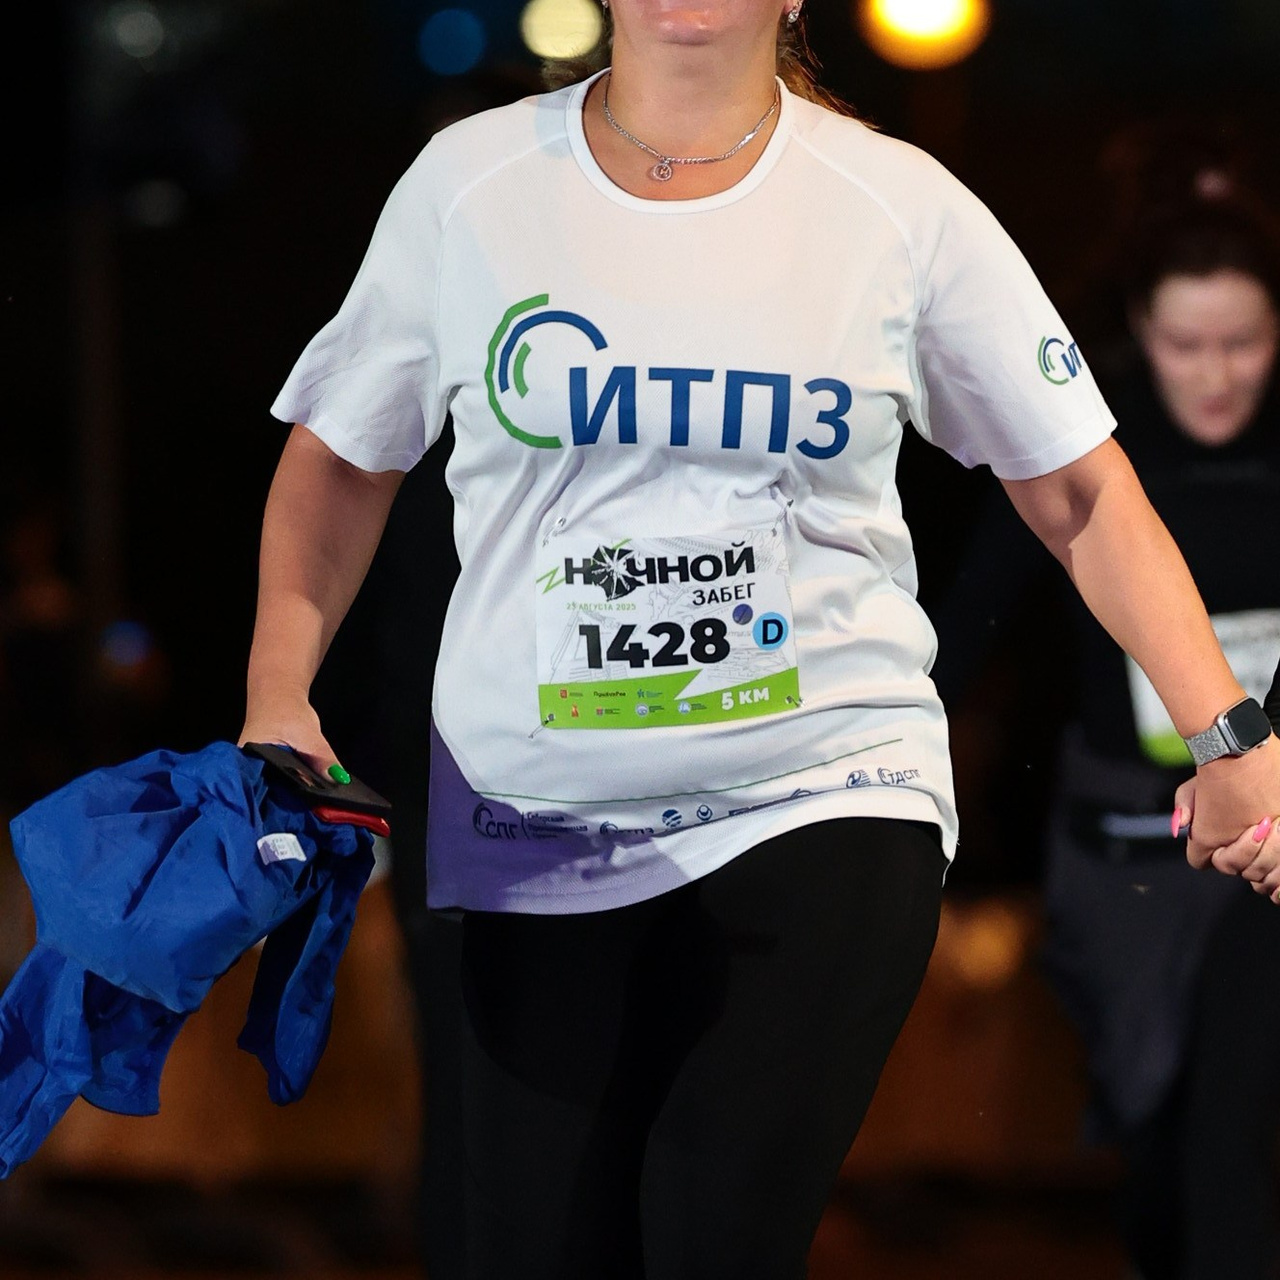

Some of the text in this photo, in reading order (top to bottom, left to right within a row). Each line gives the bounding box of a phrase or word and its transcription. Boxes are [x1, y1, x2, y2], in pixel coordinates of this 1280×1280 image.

[568, 365, 853, 460] ИТПЗ
[692, 582, 756, 606] ЗАБЕГ
[578, 618, 731, 669] 1428
[762, 619, 783, 645] D
[721, 687, 770, 711] 5 КМ
